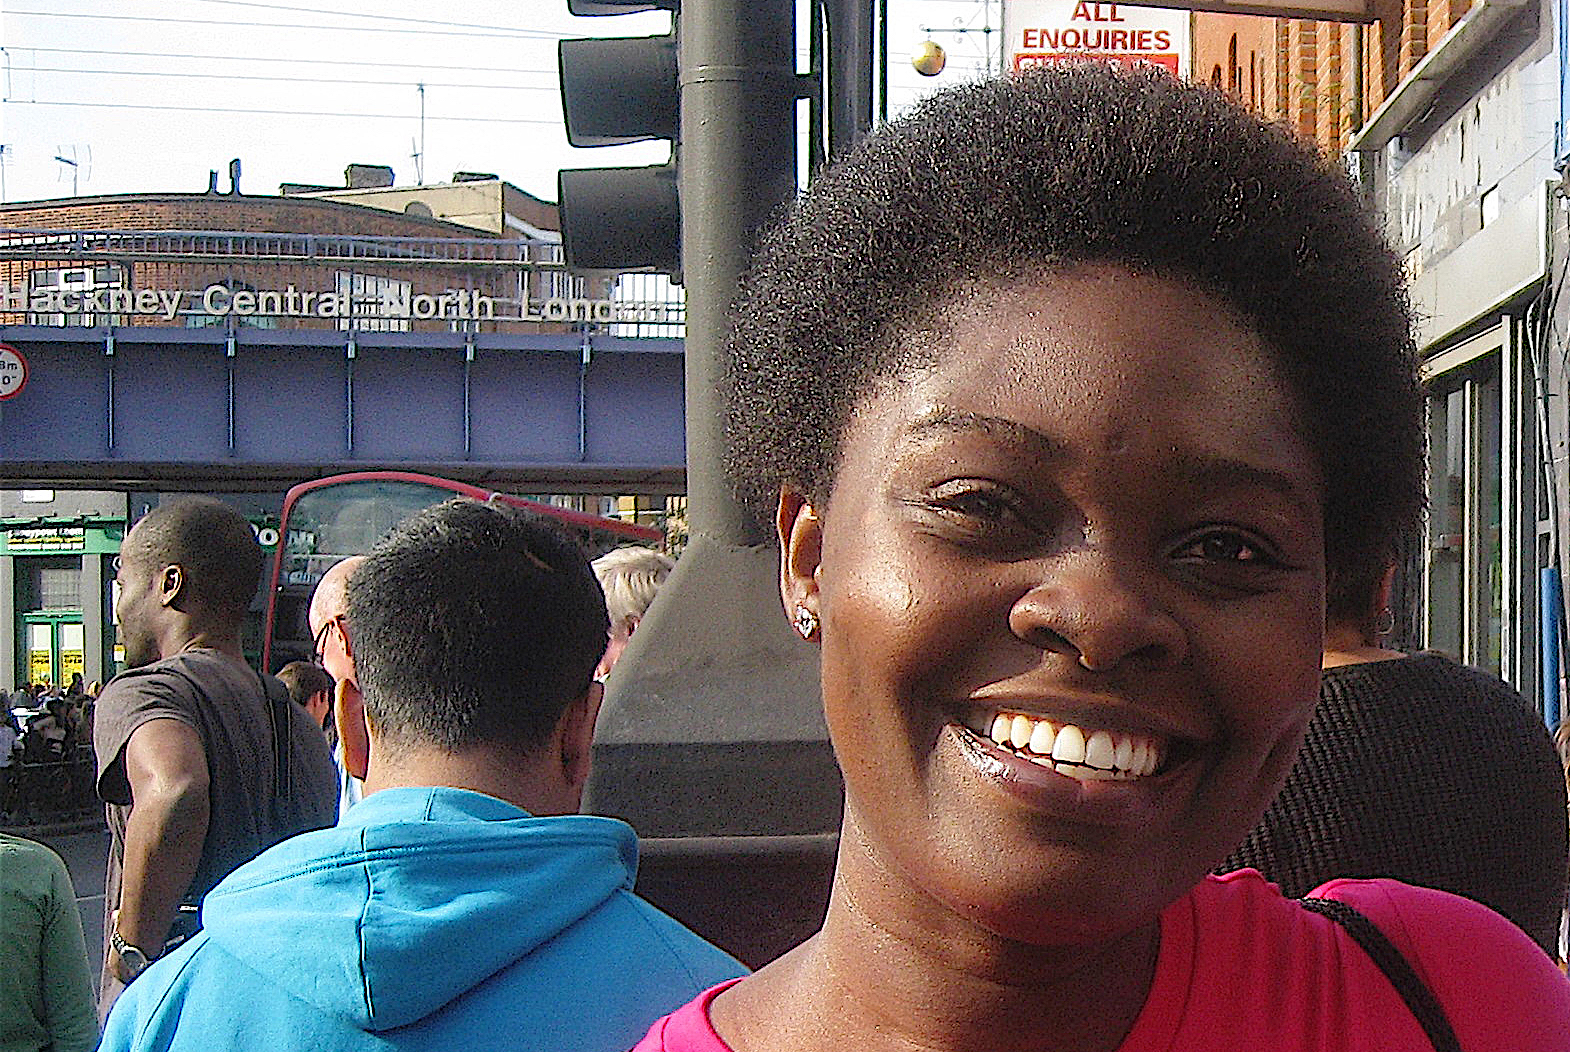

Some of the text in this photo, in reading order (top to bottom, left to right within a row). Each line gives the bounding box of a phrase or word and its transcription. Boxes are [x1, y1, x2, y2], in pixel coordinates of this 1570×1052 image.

[1071, 2, 1125, 22] ALL
[1023, 28, 1171, 51] ENQUIRIES
[2, 281, 183, 320] Hackney
[203, 283, 348, 317] Central
[382, 282, 495, 319] North
